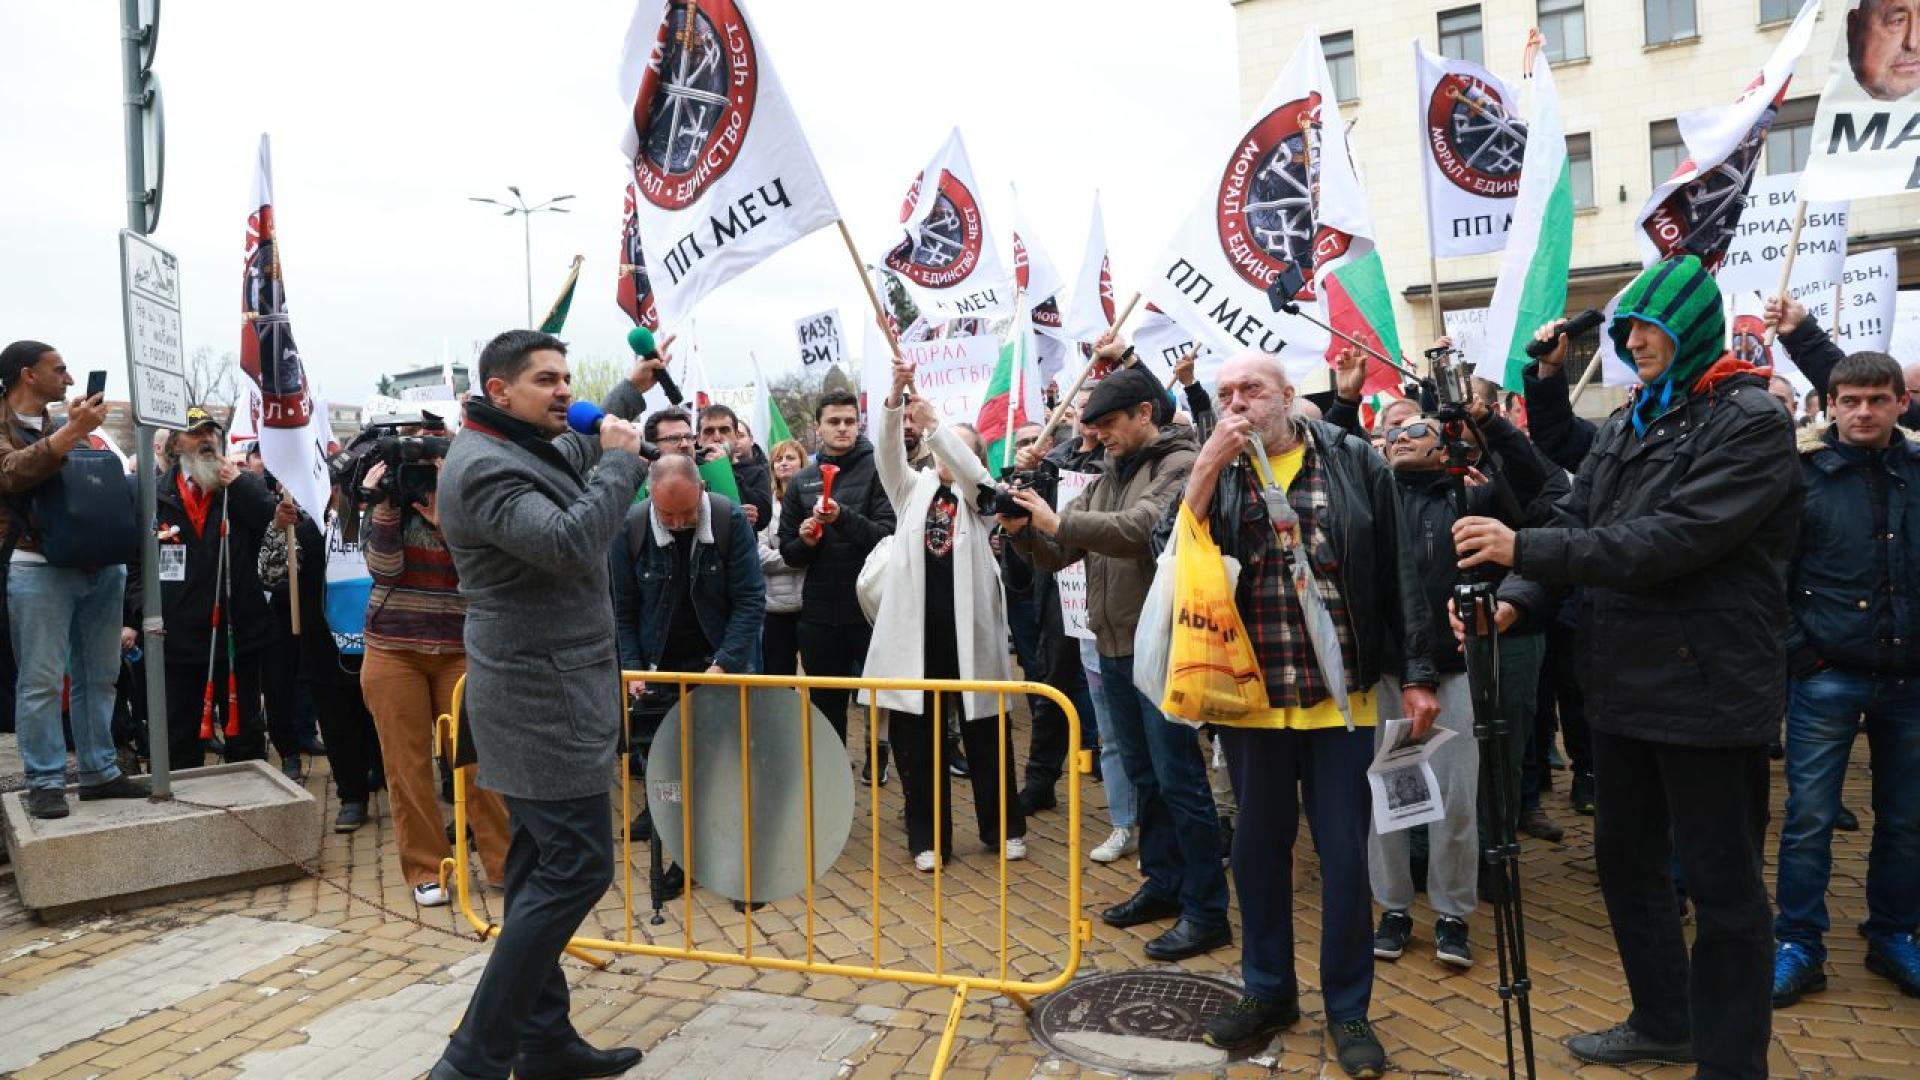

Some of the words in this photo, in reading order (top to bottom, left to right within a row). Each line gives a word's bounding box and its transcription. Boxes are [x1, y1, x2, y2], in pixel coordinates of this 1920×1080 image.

[725, 23, 749, 86] ЧЕСТ
[676, 110, 743, 202] ЕДИНСТВО
[1432, 127, 1464, 178] МОРАЛ
[635, 154, 665, 196] ОРАЛ
[1224, 141, 1260, 215] МОРАЛ
[663, 231, 705, 285] ПП
[710, 177, 793, 247] МЕЧ
[964, 207, 978, 240] ЧЕСТ
[1453, 215, 1492, 238] ПП
[922, 250, 975, 286] ЕДИНСТВО
[1166, 258, 1214, 304] ПП
[955, 288, 999, 315] МЕЧ
[1852, 291, 1878, 308] ЗА
